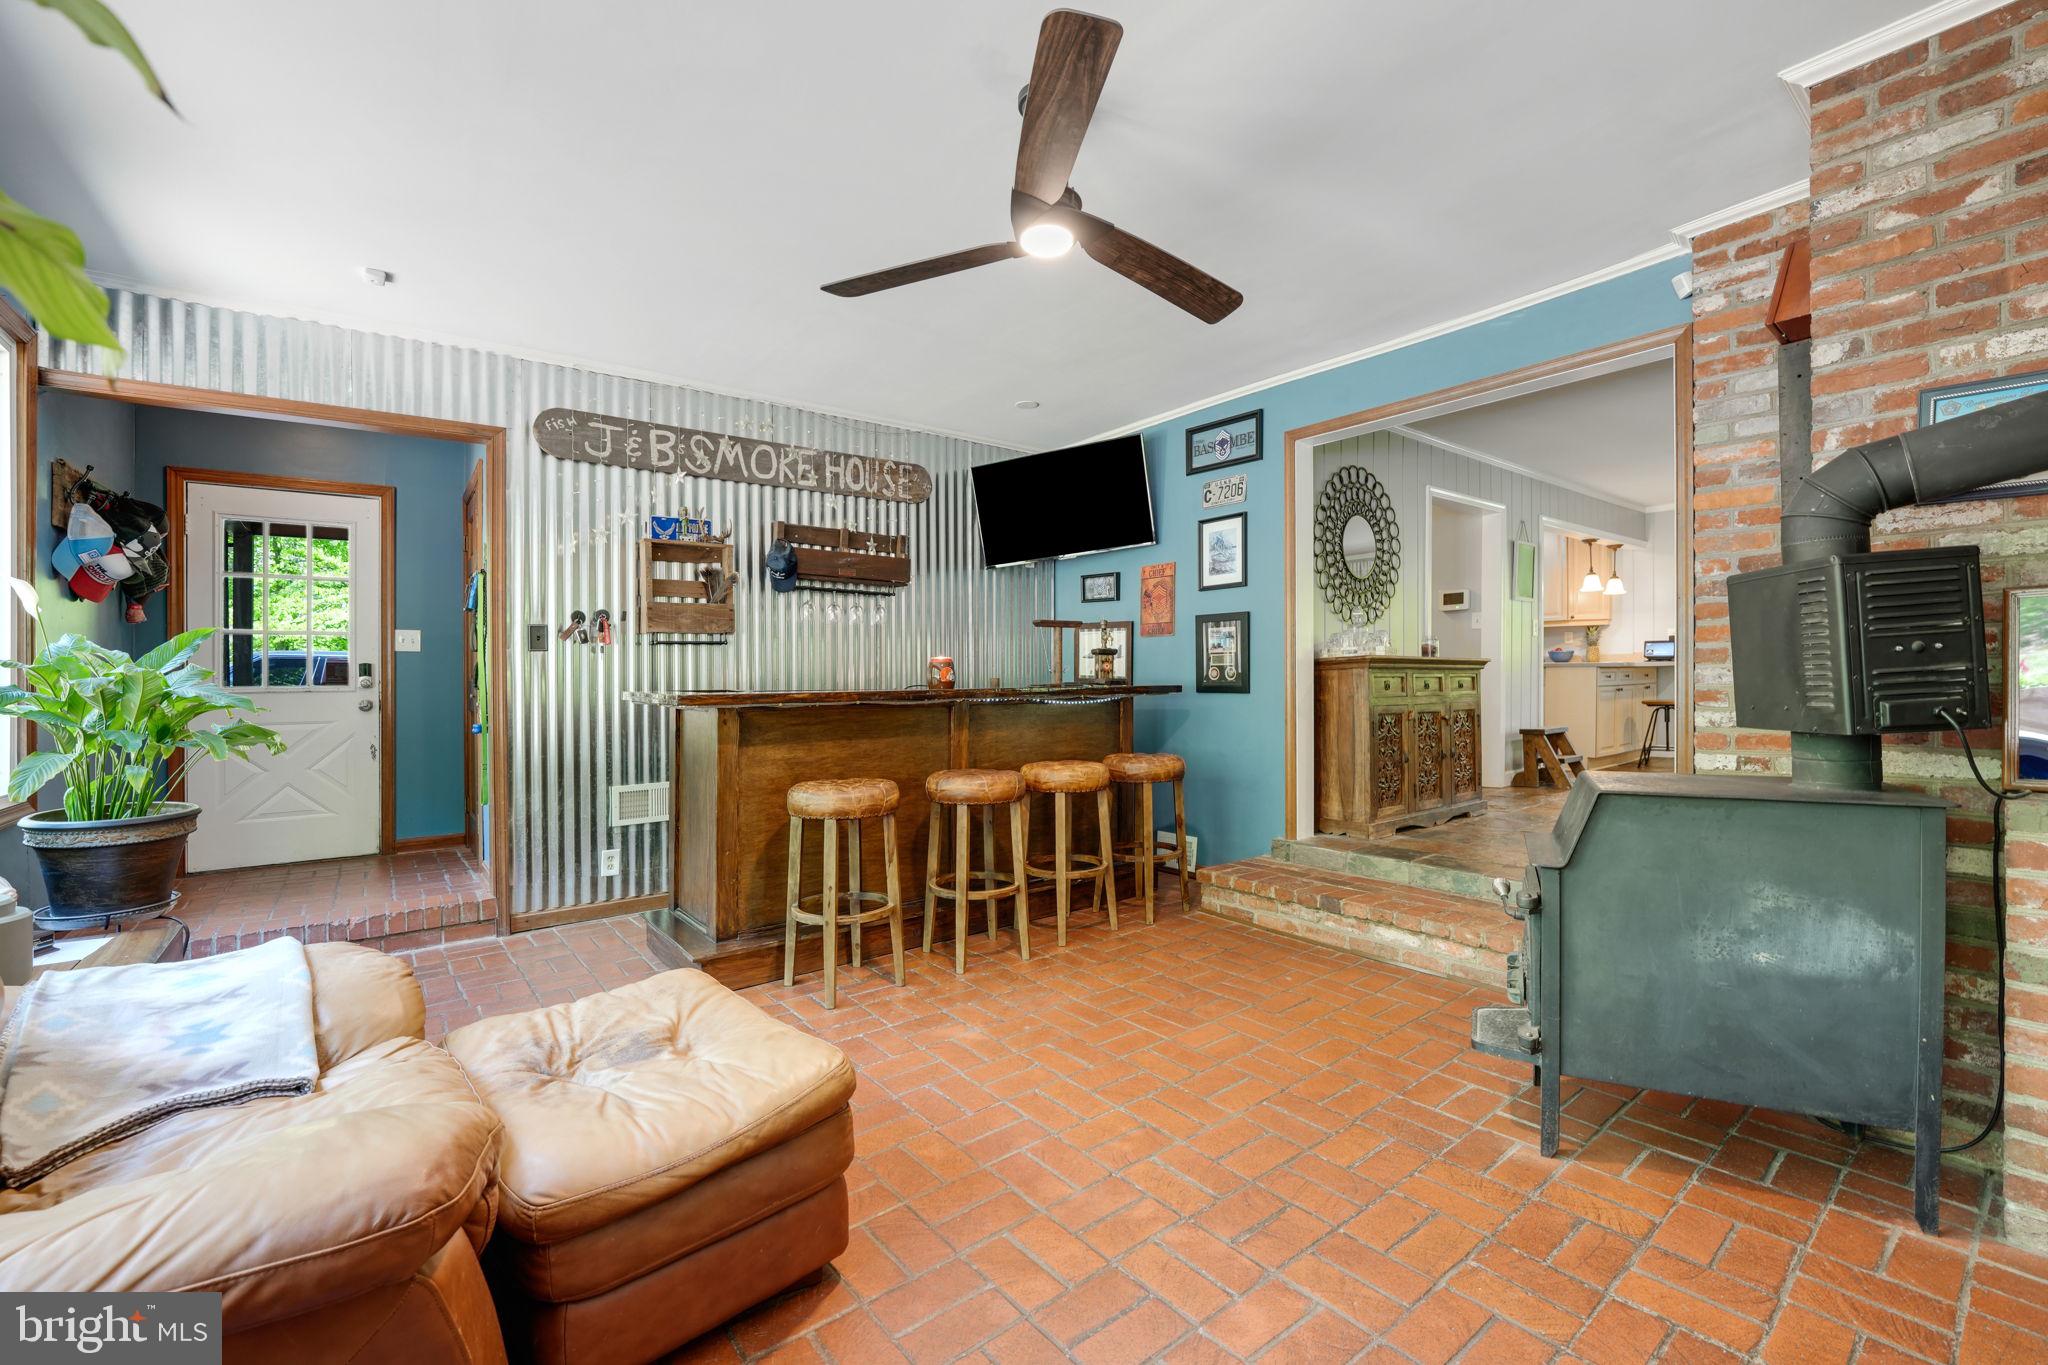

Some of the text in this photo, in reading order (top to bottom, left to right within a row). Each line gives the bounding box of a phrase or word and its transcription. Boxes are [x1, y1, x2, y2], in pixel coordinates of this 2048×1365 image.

[584, 421, 624, 458] J
[684, 434, 818, 487] SMOKE
[824, 453, 914, 500] HOUSE
[1204, 482, 1244, 503] C-7206
[1148, 568, 1167, 577] CHIEF
